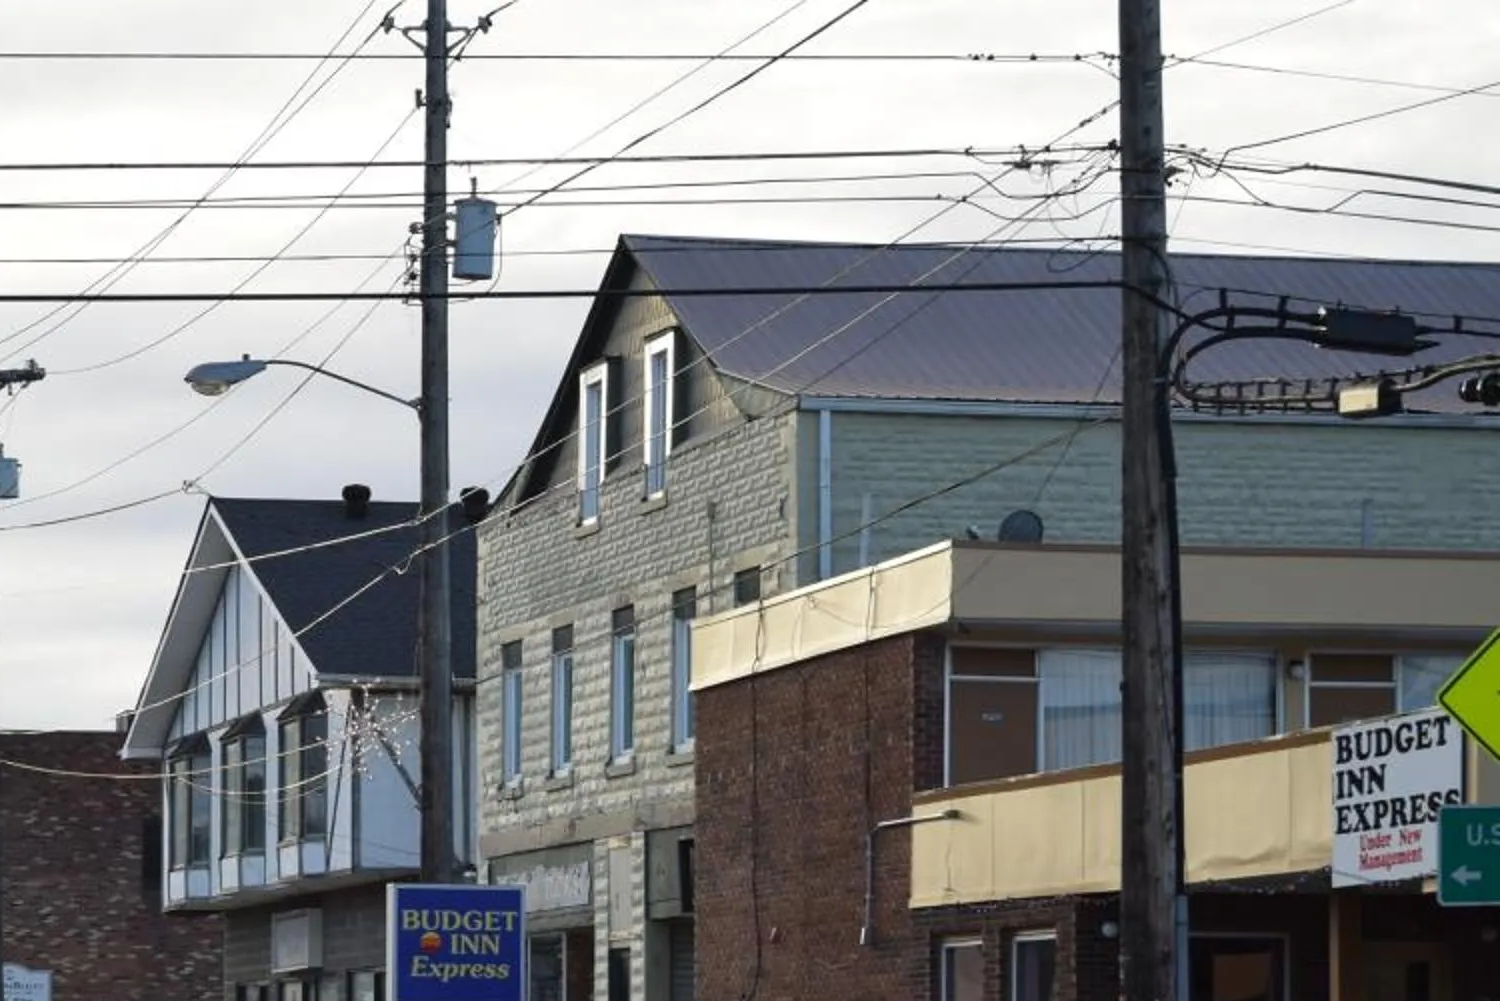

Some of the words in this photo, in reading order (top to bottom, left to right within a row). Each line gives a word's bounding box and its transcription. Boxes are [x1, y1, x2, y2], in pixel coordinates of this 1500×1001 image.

[1336, 716, 1450, 763] BUDGET
[1336, 763, 1387, 799] INN
[1360, 832, 1392, 851] Under
[1400, 828, 1423, 846] New
[1360, 848, 1422, 871] Management
[402, 909, 517, 930] BUDGET
[451, 933, 499, 954] INN
[411, 955, 510, 981] Express
